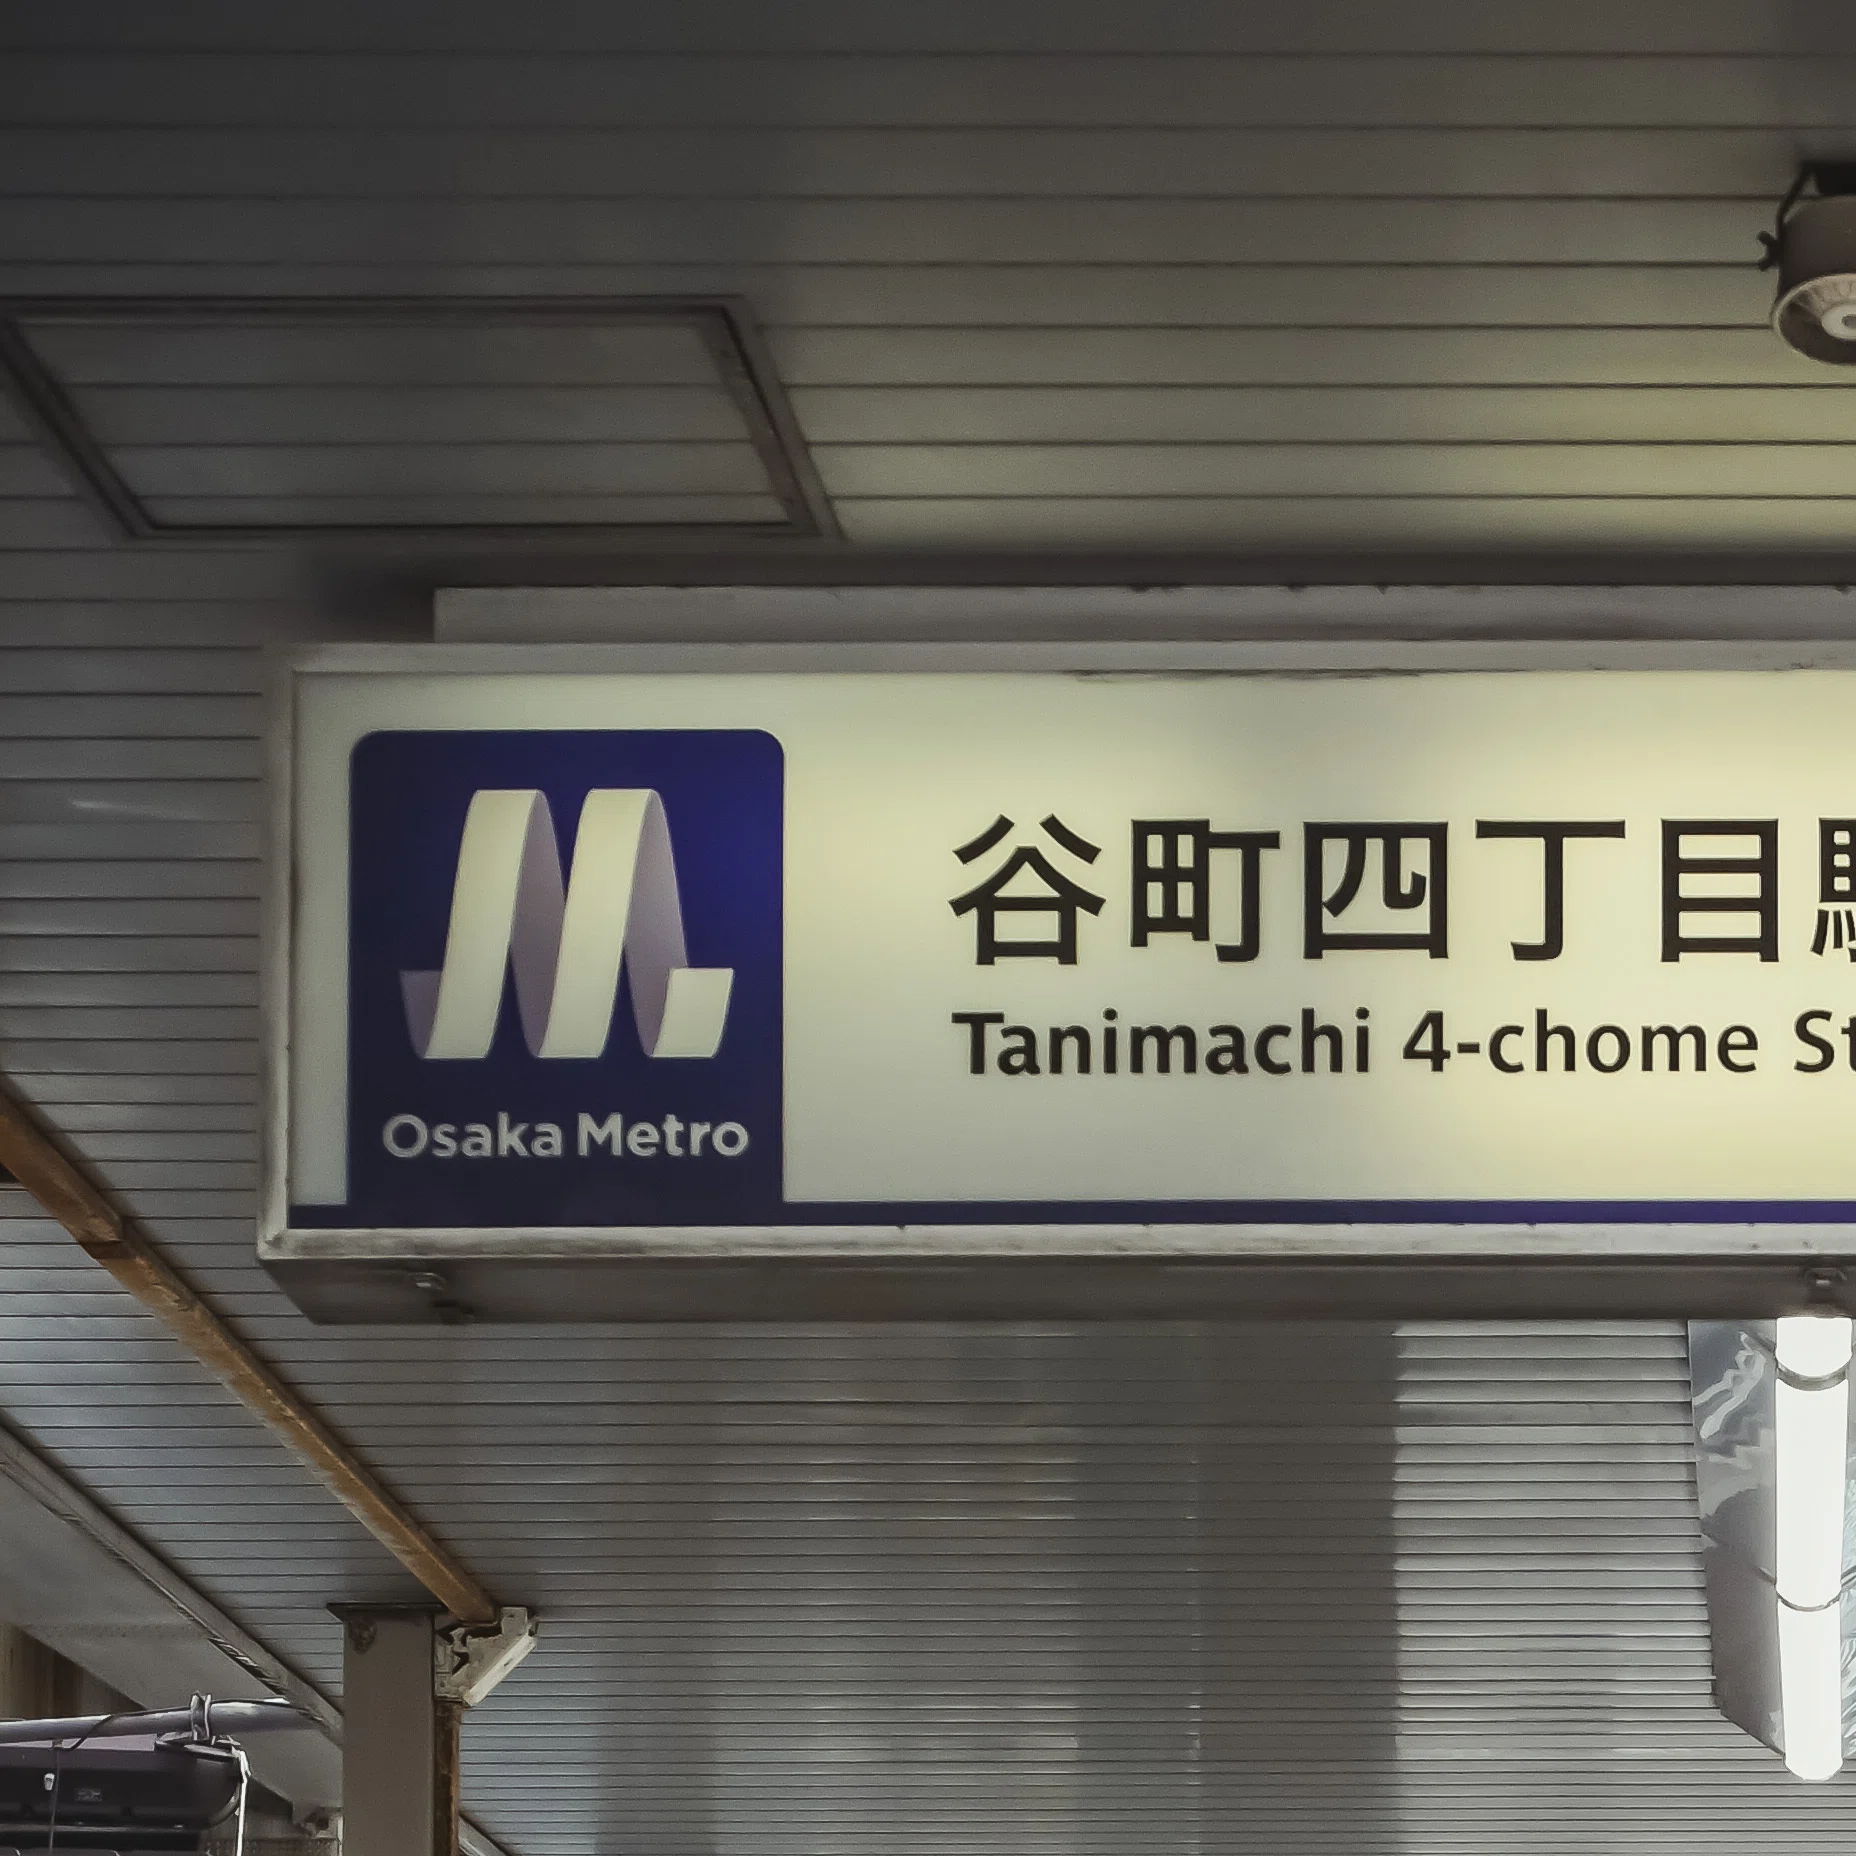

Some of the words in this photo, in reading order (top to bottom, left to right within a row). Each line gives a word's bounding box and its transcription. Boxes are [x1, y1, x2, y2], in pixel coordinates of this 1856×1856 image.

[951, 1006, 1371, 1076] Tanimachi
[1402, 1007, 1760, 1074] 4-chome
[381, 1111, 563, 1159] Osaka
[577, 1111, 749, 1159] Metro
